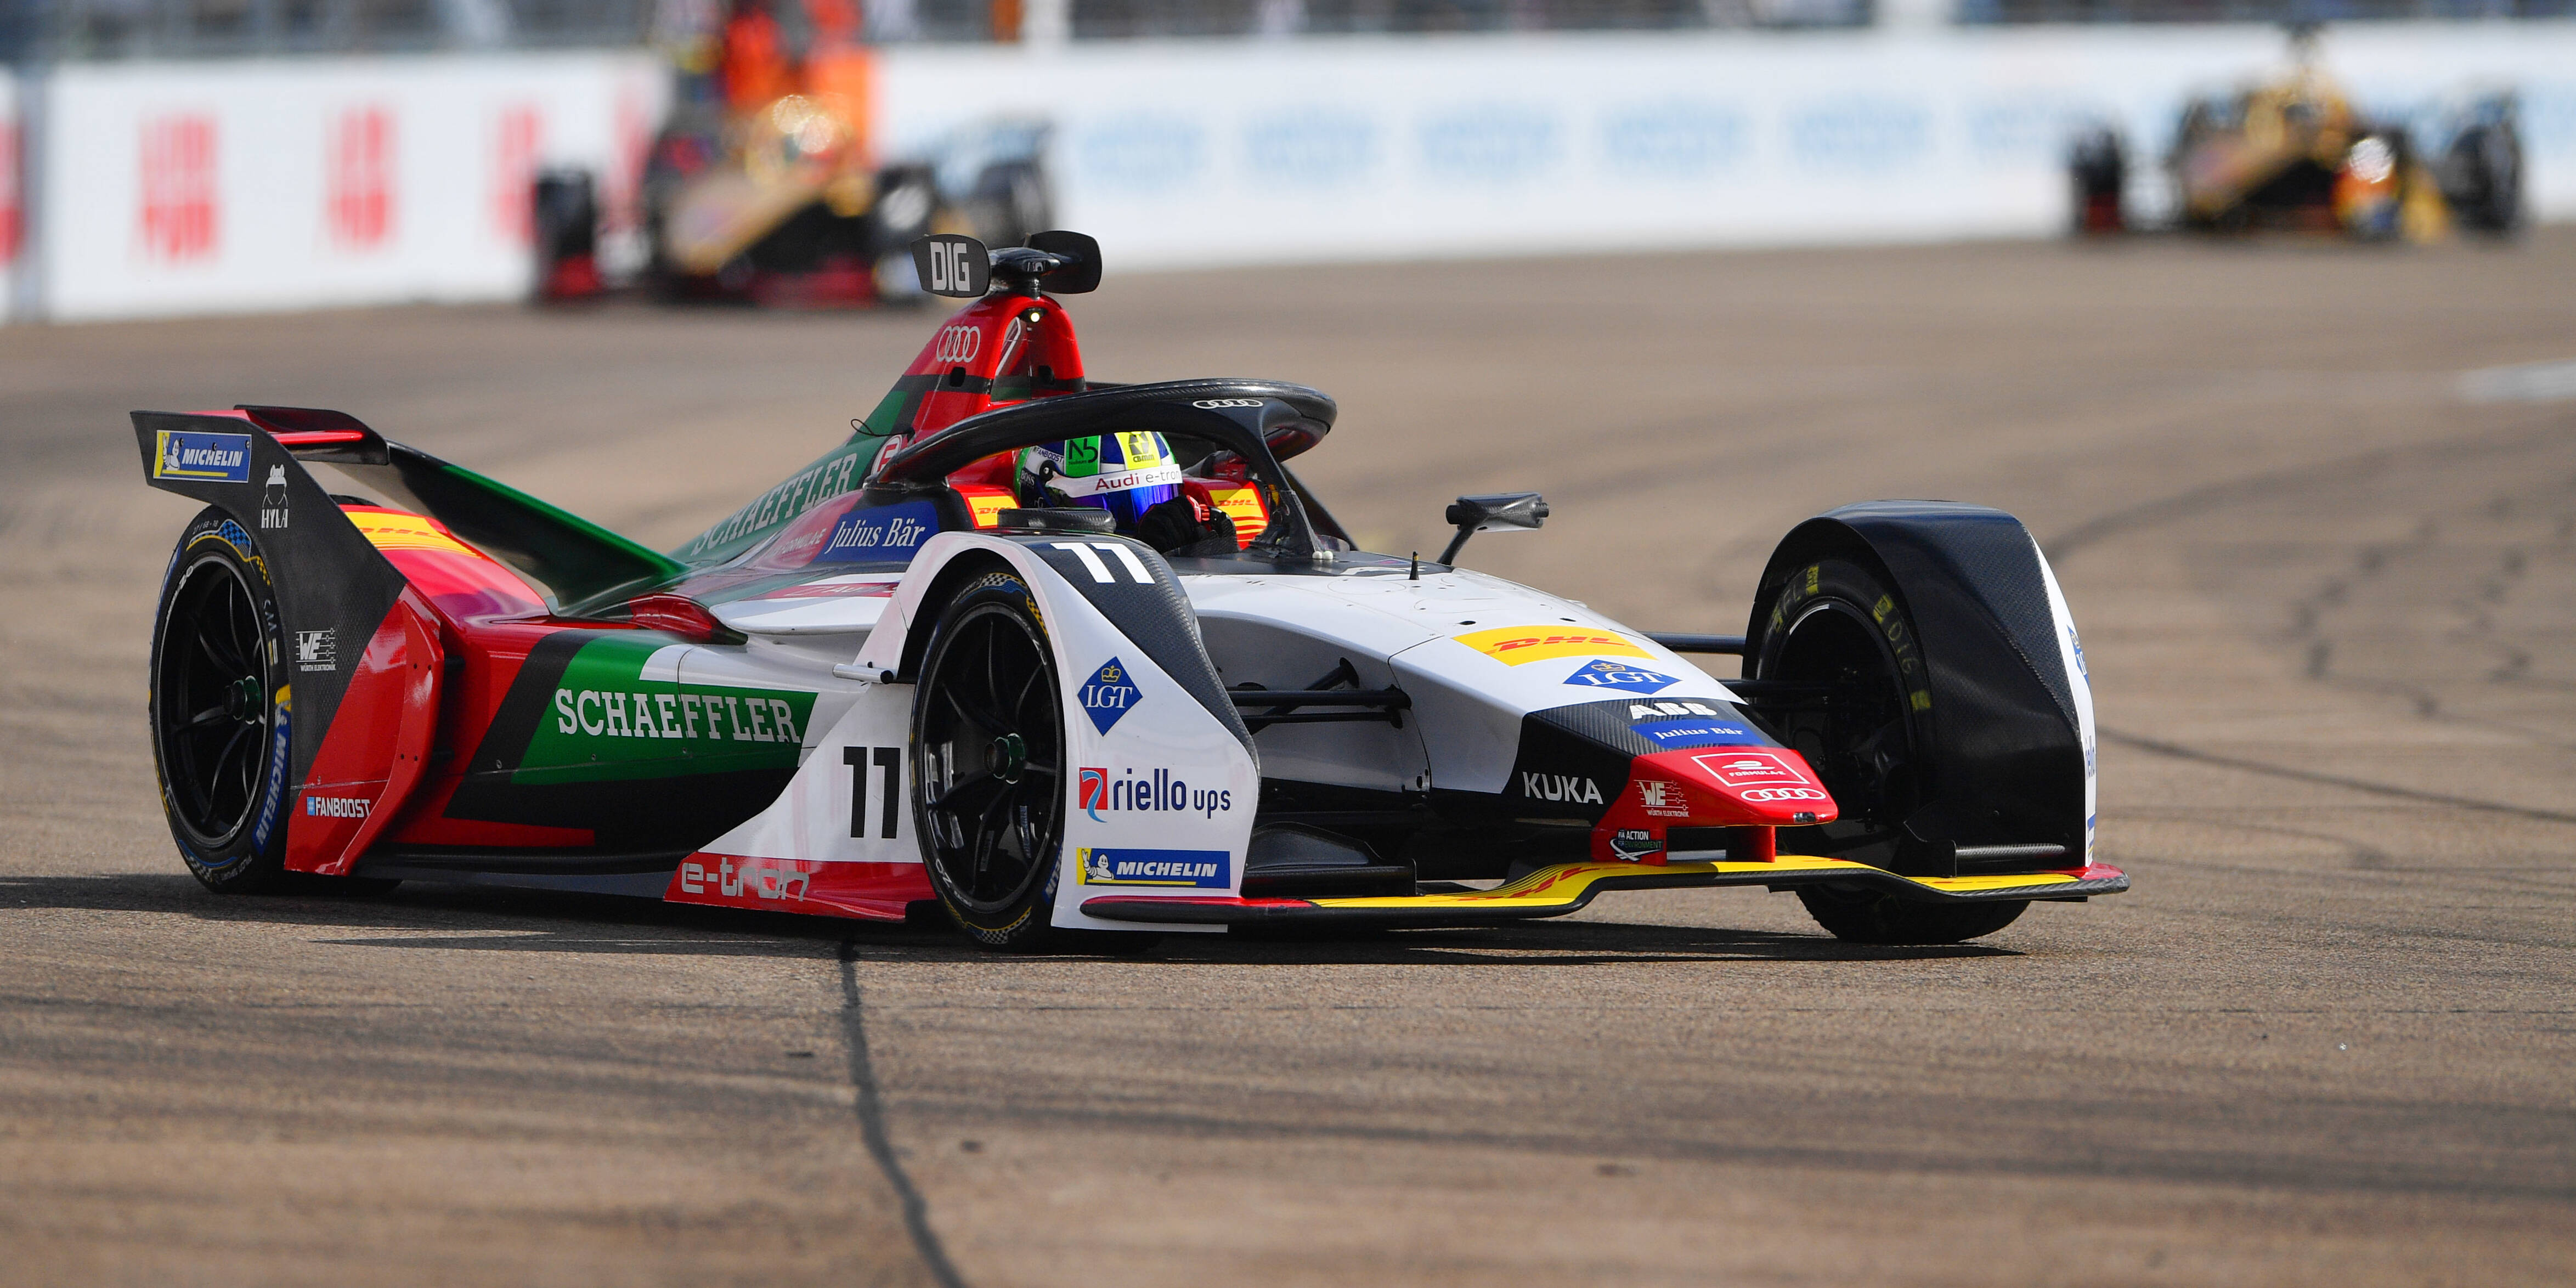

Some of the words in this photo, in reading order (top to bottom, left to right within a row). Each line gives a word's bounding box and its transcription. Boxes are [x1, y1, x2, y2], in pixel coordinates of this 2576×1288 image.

[930, 241, 970, 291] DIG
[182, 449, 243, 466] MICHELIN
[1095, 473, 1139, 490] Audi
[1145, 469, 1180, 483] e-tron
[690, 453, 857, 556] SCHAEFFLER
[261, 509, 289, 528] HYLA
[824, 520, 882, 555] Julius
[882, 518, 926, 547] Bär
[1050, 543, 1155, 584] 11
[1493, 636, 1626, 652] DHL
[1578, 671, 1665, 686] LGT
[1085, 685, 1134, 709] LGT
[554, 688, 801, 743] SCHAEFFLER
[1629, 702, 1717, 719] ABB
[1654, 727, 1708, 739] Julius
[256, 733, 287, 845] MICHELIN
[843, 746, 901, 839] 11
[1113, 768, 1187, 811] riello
[1194, 789, 1231, 819] ups
[1522, 772, 1603, 805] KUKA
[307, 796, 370, 818] #FANBOOST
[1626, 831, 1649, 840] ACTION
[681, 857, 809, 901] e-tron
[1116, 861, 1217, 878] MICHELIN
